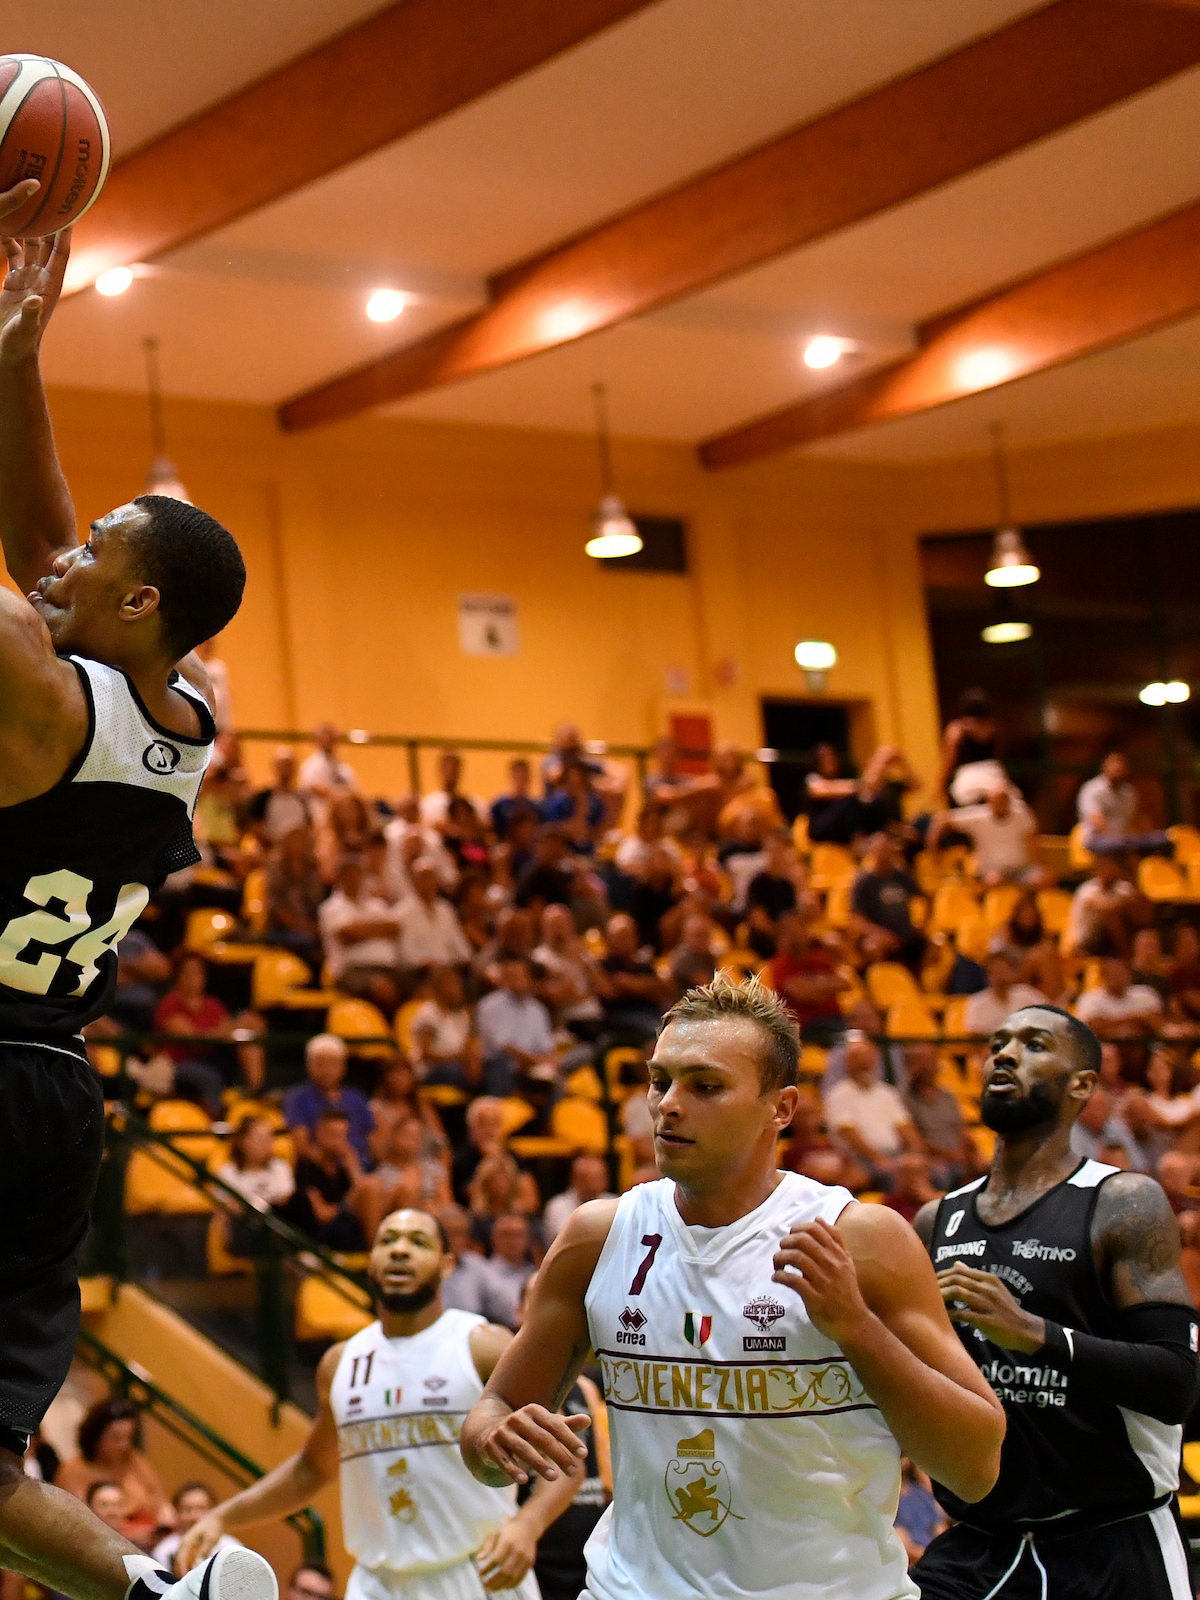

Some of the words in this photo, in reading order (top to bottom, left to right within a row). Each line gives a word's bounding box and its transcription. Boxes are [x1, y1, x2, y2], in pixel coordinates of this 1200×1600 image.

[24, 152, 48, 179] FIB
[58, 138, 91, 215] molten
[945, 1210, 965, 1238] 0
[628, 1233, 663, 1296] 7
[935, 1240, 987, 1263] SPALDING
[745, 1338, 784, 1350] UMANA
[350, 1350, 375, 1388] 11
[980, 1360, 1068, 1388] olomiti
[632, 1361, 769, 1412] VENEZIA
[994, 1387, 1067, 1408] energia
